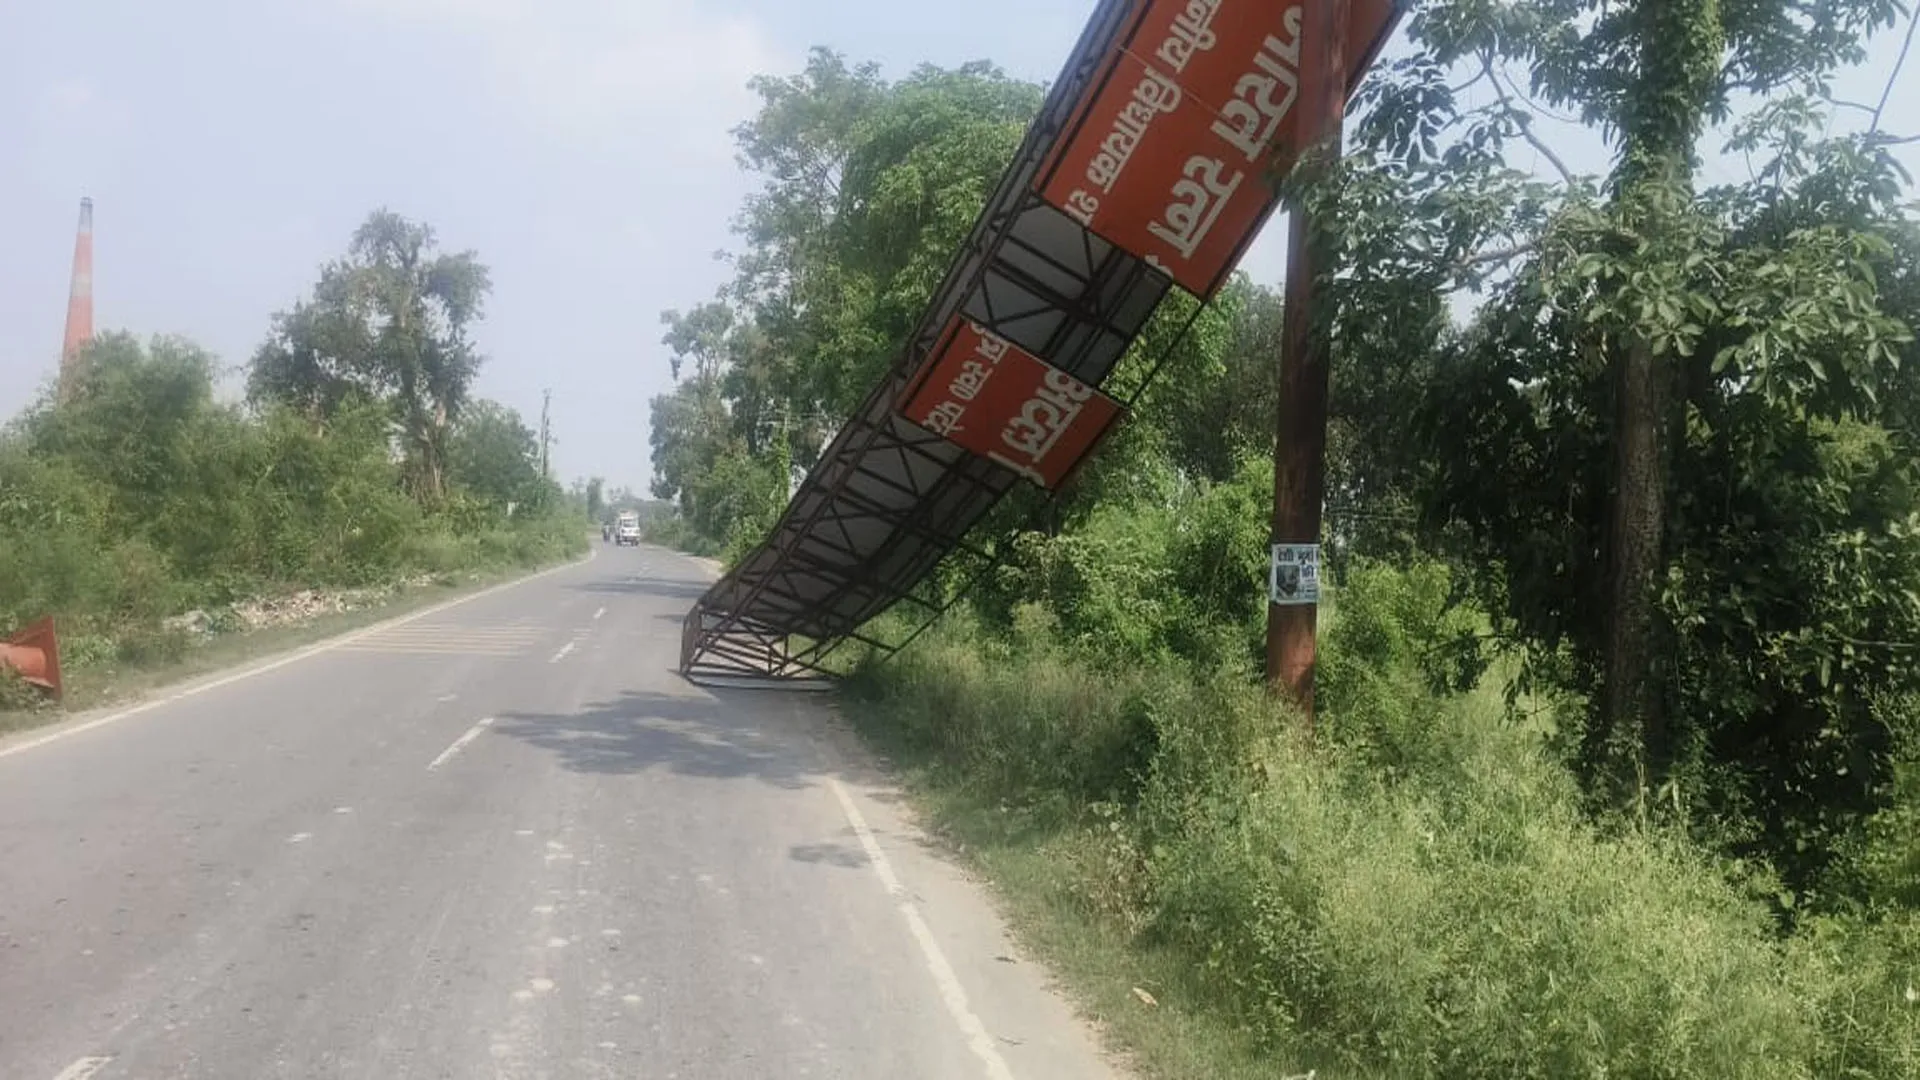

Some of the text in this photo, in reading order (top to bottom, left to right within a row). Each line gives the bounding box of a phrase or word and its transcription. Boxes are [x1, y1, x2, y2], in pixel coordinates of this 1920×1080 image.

[1087, 65, 1182, 195] विधायक
[1147, 155, 1244, 259] रत्न
[1002, 369, 1094, 462] अटल
